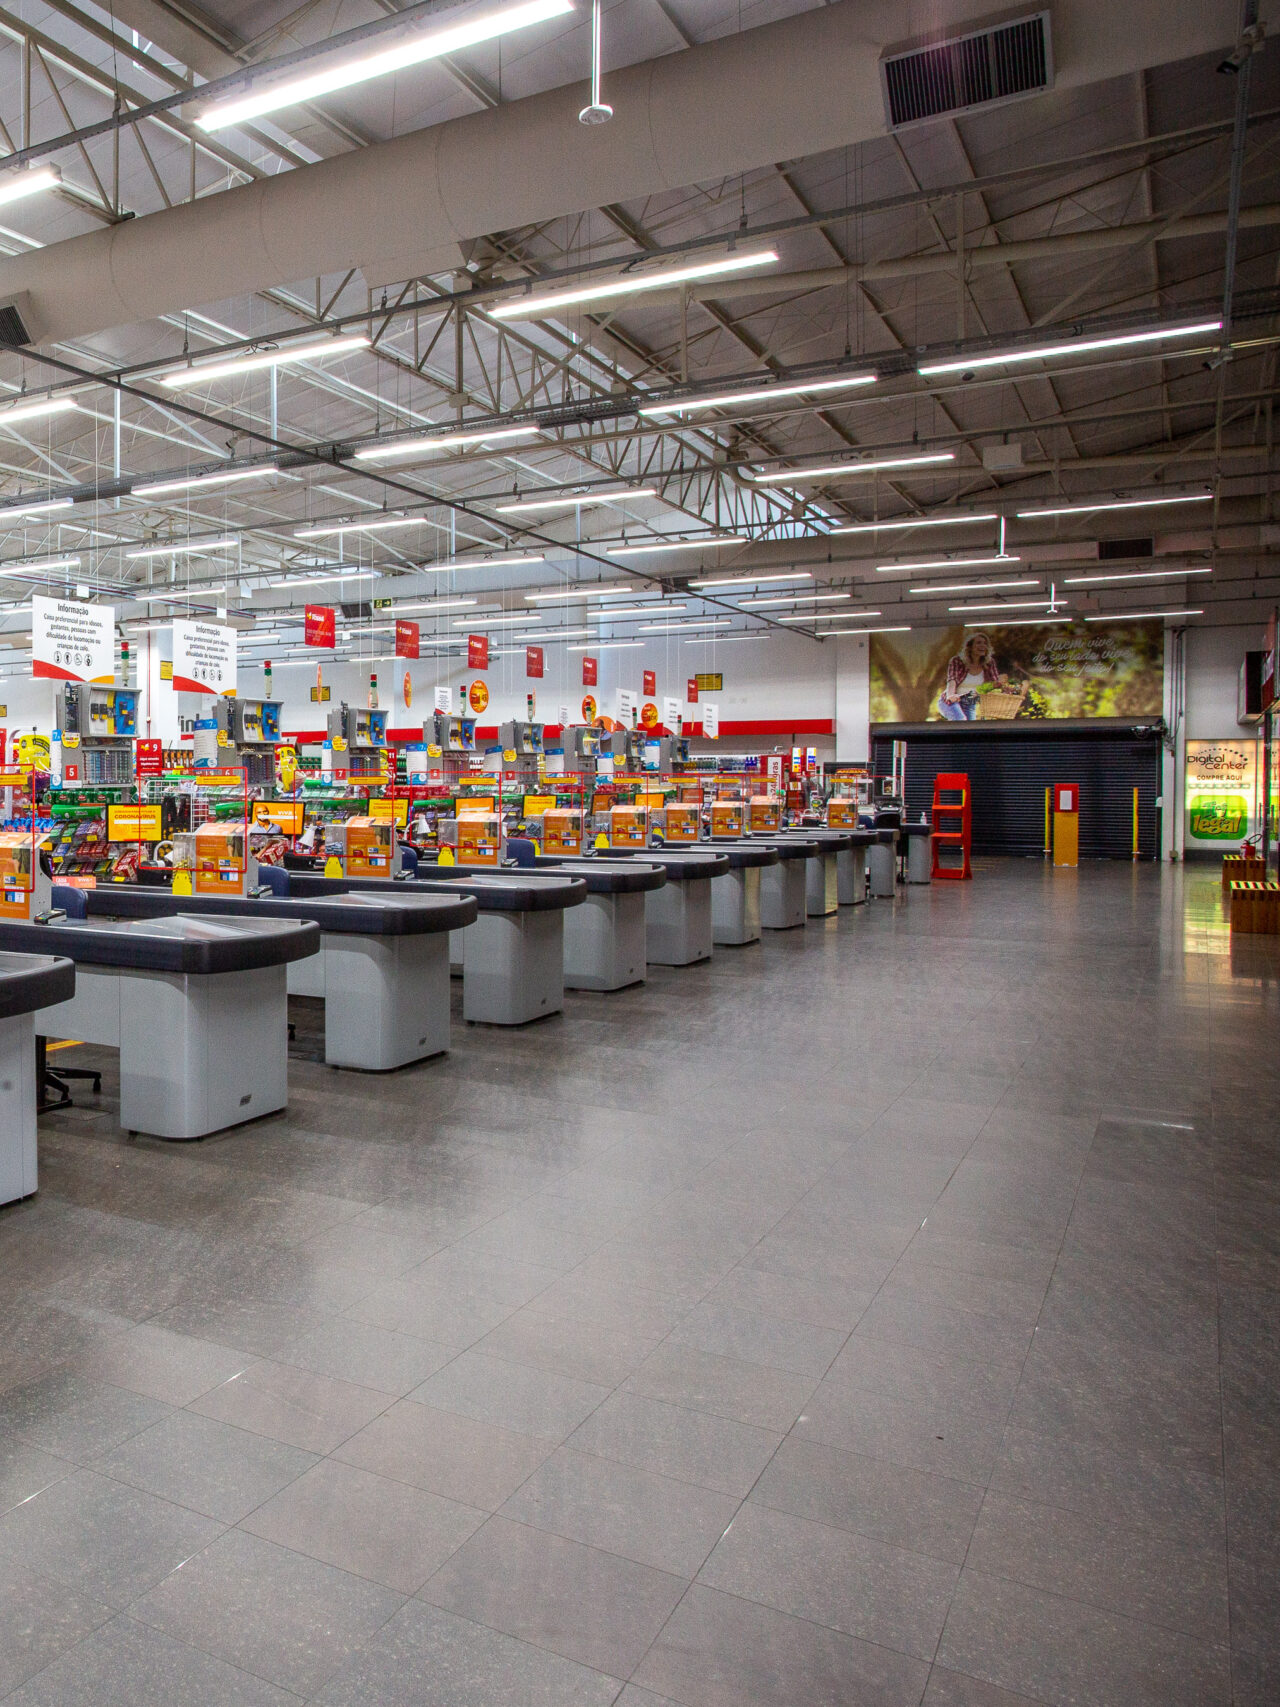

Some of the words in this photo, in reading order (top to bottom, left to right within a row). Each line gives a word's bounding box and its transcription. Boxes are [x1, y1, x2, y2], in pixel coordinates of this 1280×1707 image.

[58, 604, 88, 616] Informação
[1044, 638, 1084, 652] Quem
[152, 744, 158, 752] 9
[1187, 754, 1224, 765] Digital
[1205, 762, 1248, 770] Center
[69, 768, 74, 776] 5
[1194, 815, 1242, 834] legal
